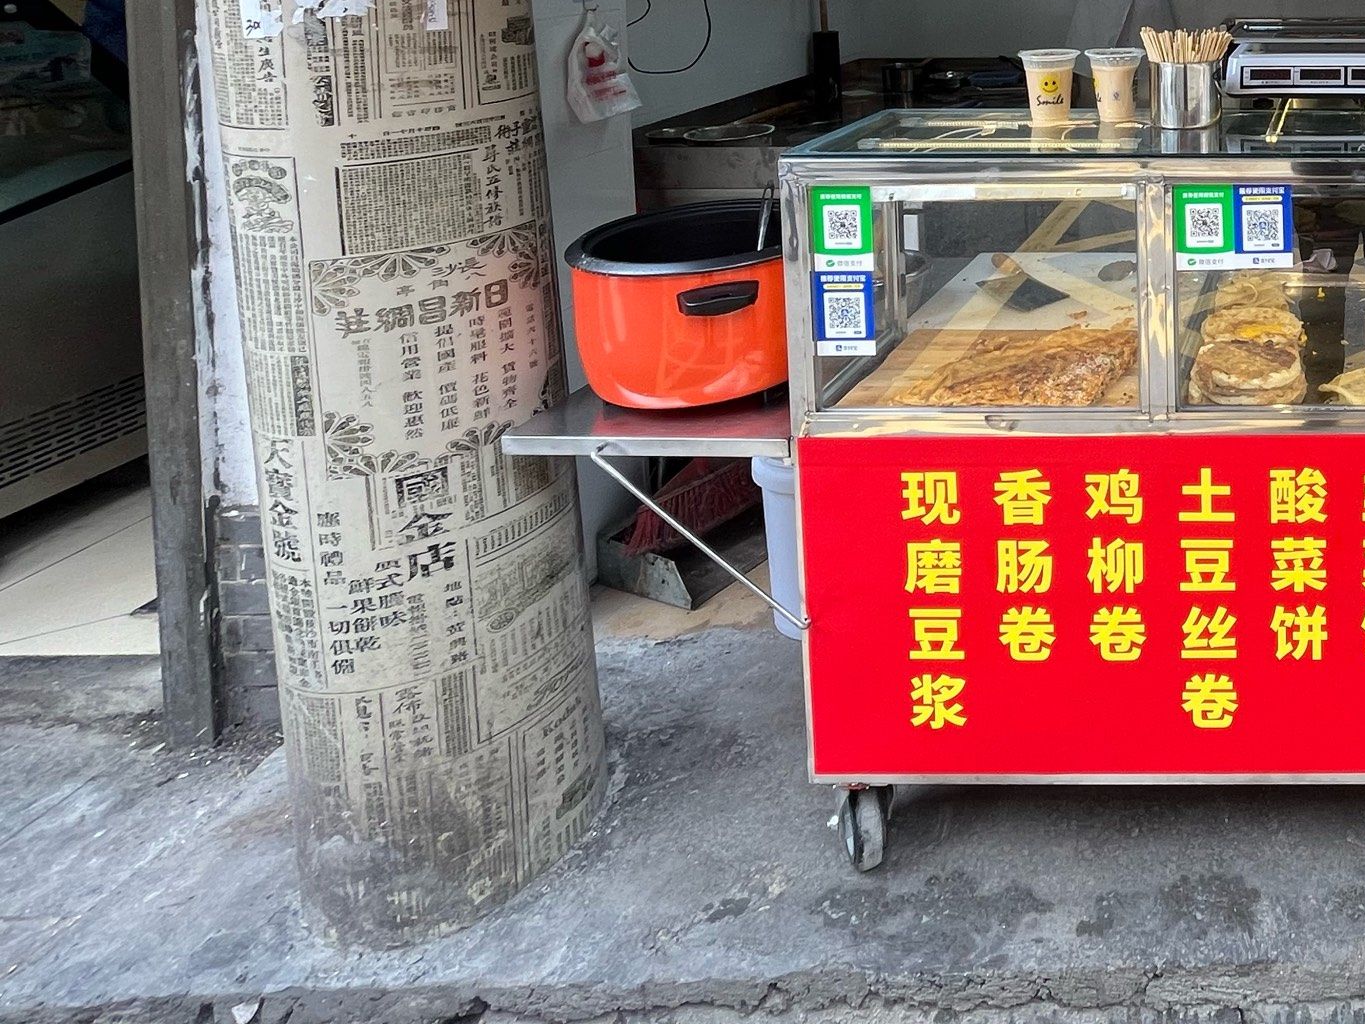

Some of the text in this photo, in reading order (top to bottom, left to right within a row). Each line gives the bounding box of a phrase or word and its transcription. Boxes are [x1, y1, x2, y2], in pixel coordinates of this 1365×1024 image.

[1036, 93, 1064, 107] Smile
[900, 470, 967, 730] 现磨豆浆
[993, 468, 1056, 661] 香肠卷
[1084, 468, 1147, 662] 鸡柳卷
[1178, 467, 1239, 729] 土豆丝卷
[1269, 467, 1328, 661] 酸菜饼
